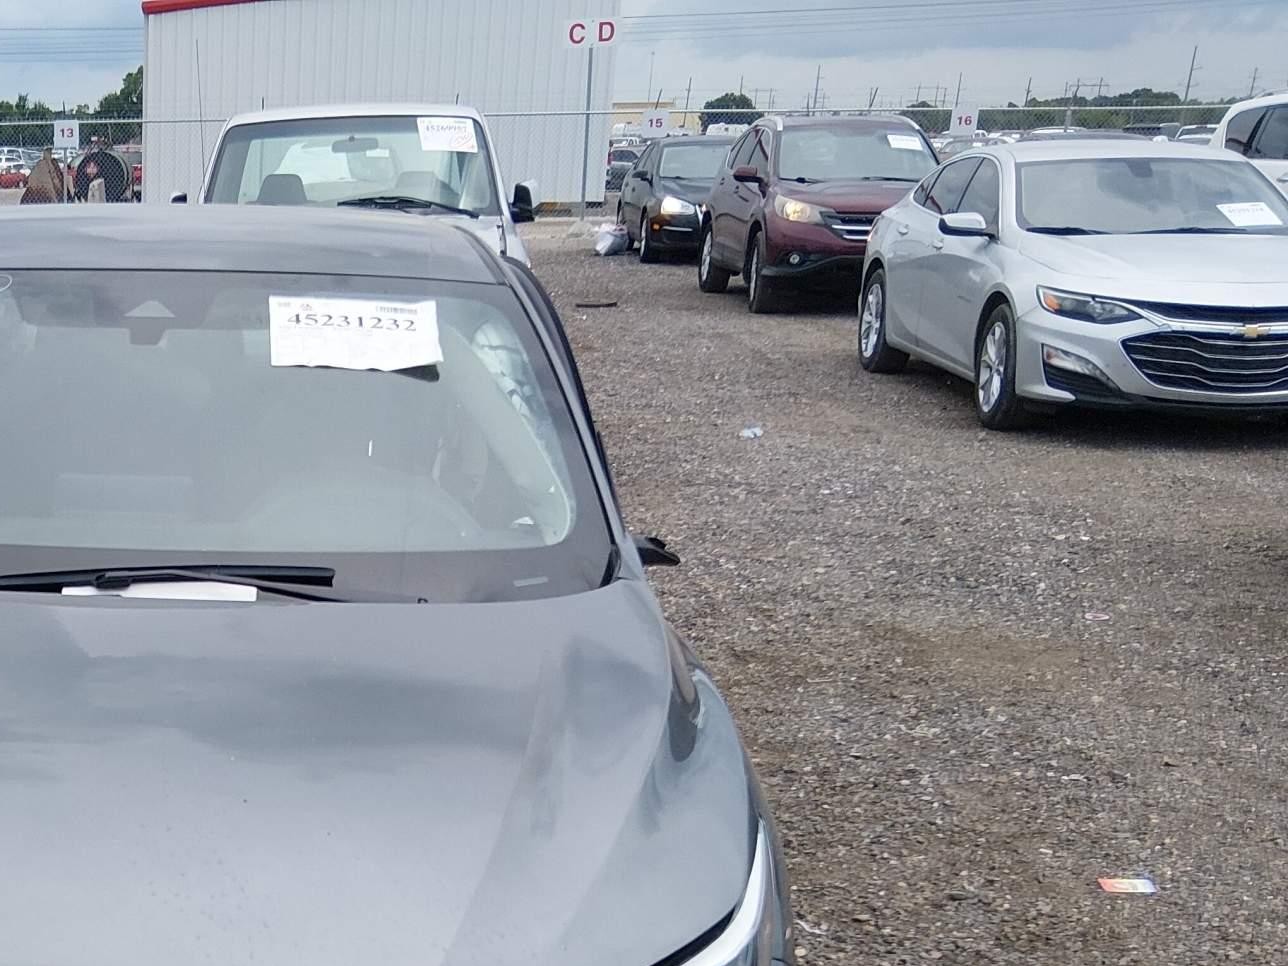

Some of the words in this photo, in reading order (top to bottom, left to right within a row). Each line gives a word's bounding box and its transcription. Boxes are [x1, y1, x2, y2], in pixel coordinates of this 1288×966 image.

[569, 23, 586, 44] C
[598, 21, 615, 42] D
[648, 118, 663, 128] 15
[957, 115, 972, 126] 16
[59, 127, 74, 138] 13
[287, 313, 417, 332] 45231232
